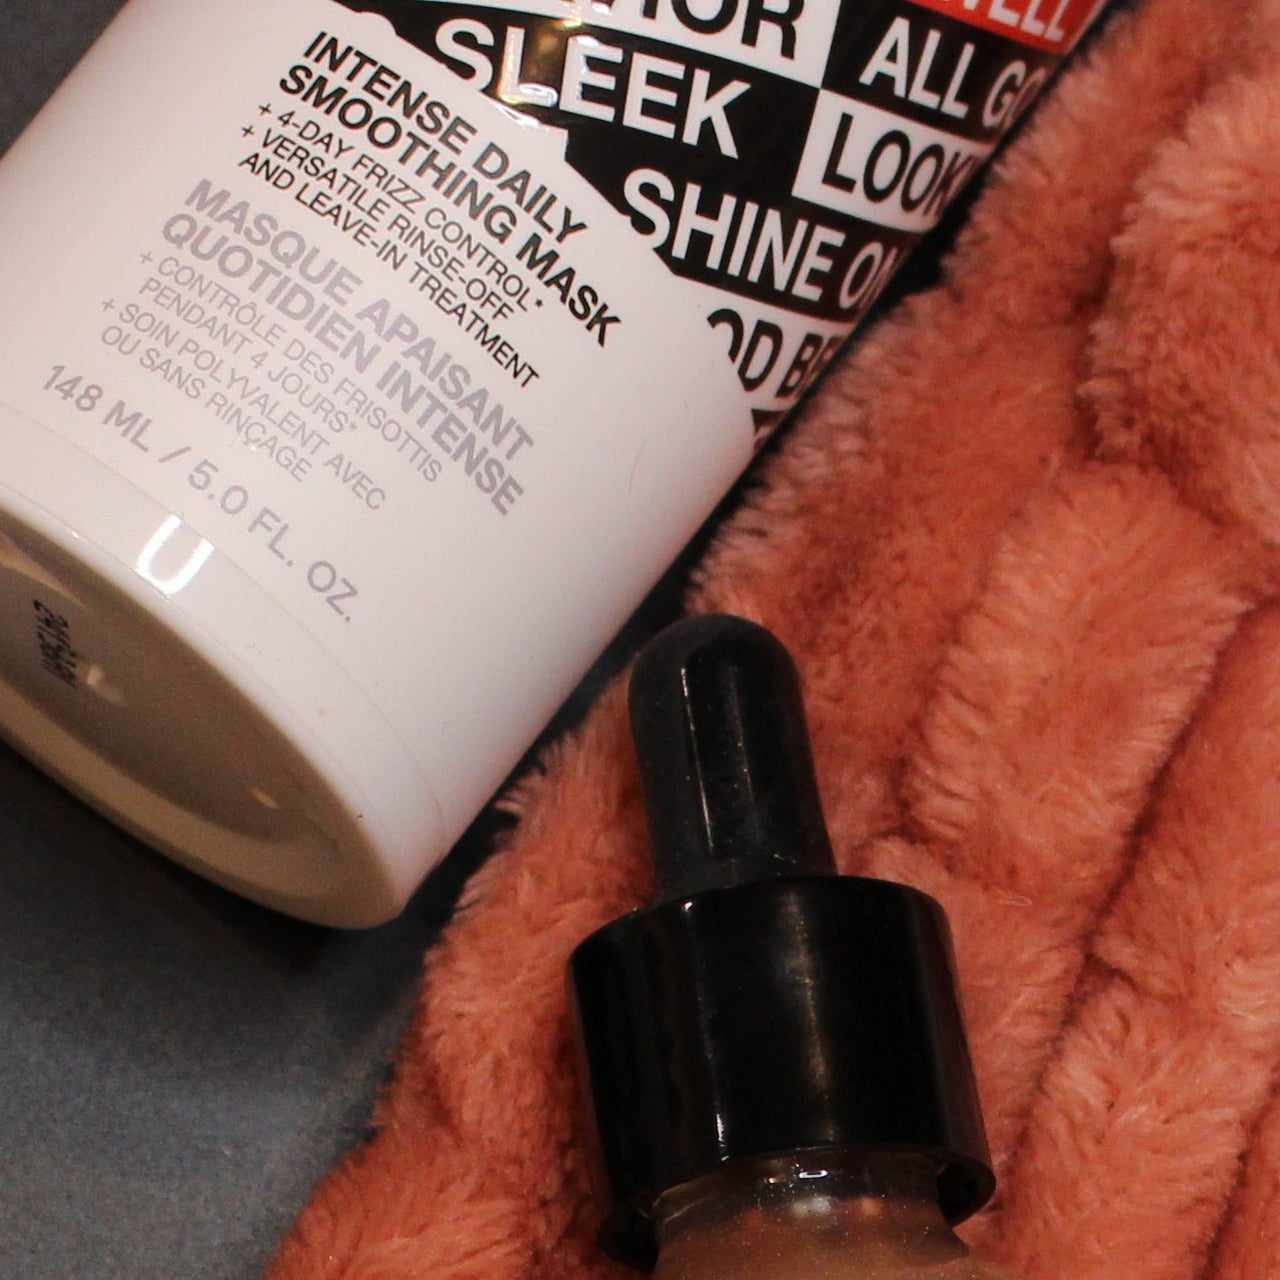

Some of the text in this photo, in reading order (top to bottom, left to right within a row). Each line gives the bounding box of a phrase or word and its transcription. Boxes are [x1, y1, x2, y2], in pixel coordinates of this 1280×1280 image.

[278, 111, 354, 158] 4-DAY
[352, 154, 426, 214] FRIZZ
[304, 31, 588, 244] INTENSE DAILY
[435, 18, 751, 160] SLEEK
[821, 112, 976, 215] LOOK
[858, 16, 975, 119] ALL
[239, 152, 539, 387] AND LEAVE-IN TREATMENT
[262, 128, 391, 221] VERSATILE
[393, 212, 514, 320] RINSE-OFF
[279, 65, 621, 348] SMOOTHING MASK
[622, 167, 845, 301] SHINE
[101, 325, 312, 482] OU SANS RINÇAGE
[119, 303, 180, 349] SOIN
[177, 338, 330, 455] POLYVALENT
[323, 453, 386, 510] AVEC
[138, 277, 254, 354] PENDANT
[250, 350, 269, 369] 4
[158, 256, 287, 348] CONTRÔLE
[283, 338, 335, 384] DES
[333, 377, 443, 482] FRISOTTIS
[163, 213, 524, 516] QUOTIDIEN INTENSE
[184, 178, 363, 306] MASQUE
[355, 299, 535, 460] APAISANT
[43, 365, 103, 412] 148
[102, 399, 152, 452] ML
[188, 458, 249, 515] 5.0
[247, 506, 294, 567] FL.
[306, 560, 358, 623] OZ.
